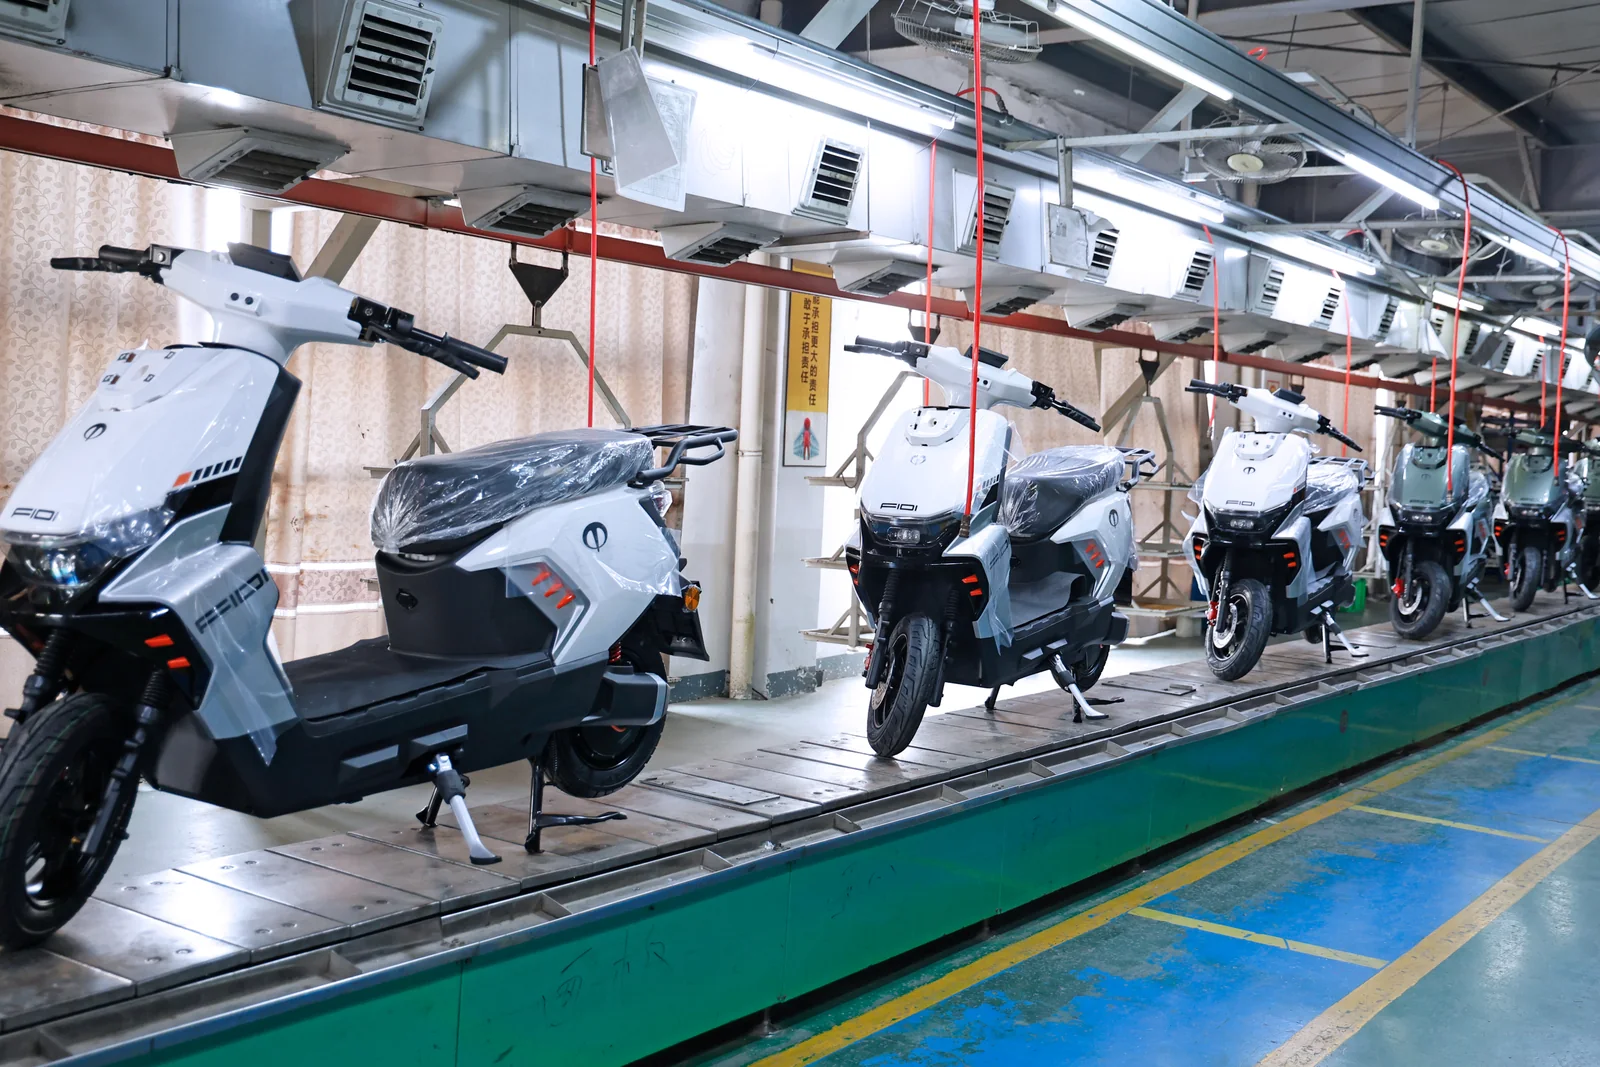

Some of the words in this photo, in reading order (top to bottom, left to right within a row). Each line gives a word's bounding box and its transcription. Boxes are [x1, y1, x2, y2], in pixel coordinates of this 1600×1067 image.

[800, 297, 812, 384] 敢于承担责任
[11, 507, 60, 522] FIDI
[880, 502, 918, 512] FIDI
[194, 567, 270, 635] FIDI
